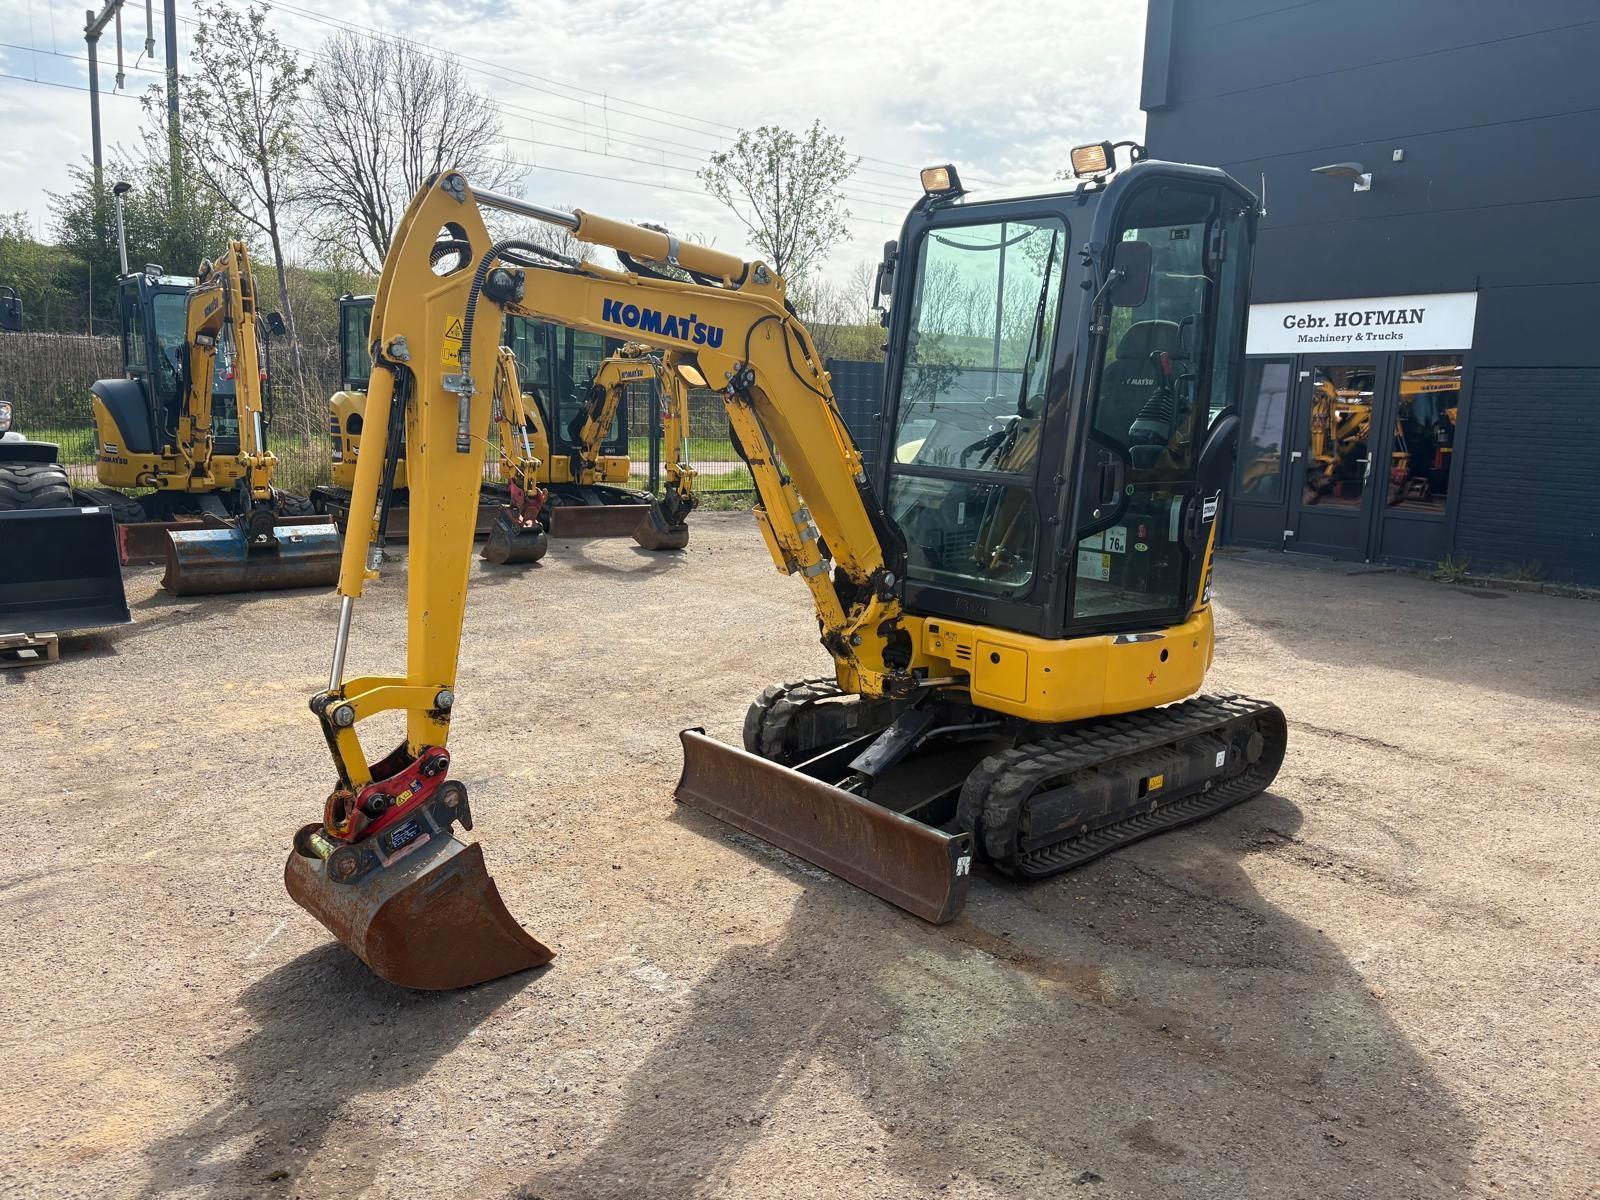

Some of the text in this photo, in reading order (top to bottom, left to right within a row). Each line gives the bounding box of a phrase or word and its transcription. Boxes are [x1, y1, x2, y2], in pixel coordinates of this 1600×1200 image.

[602, 298, 724, 349] KOMATSU
[1283, 308, 1425, 329] Gebr. HOFMAN
[1297, 331, 1404, 343] Machinery & Trucks
[1121, 377, 1154, 385] MATSU
[1110, 537, 1120, 550] 76
